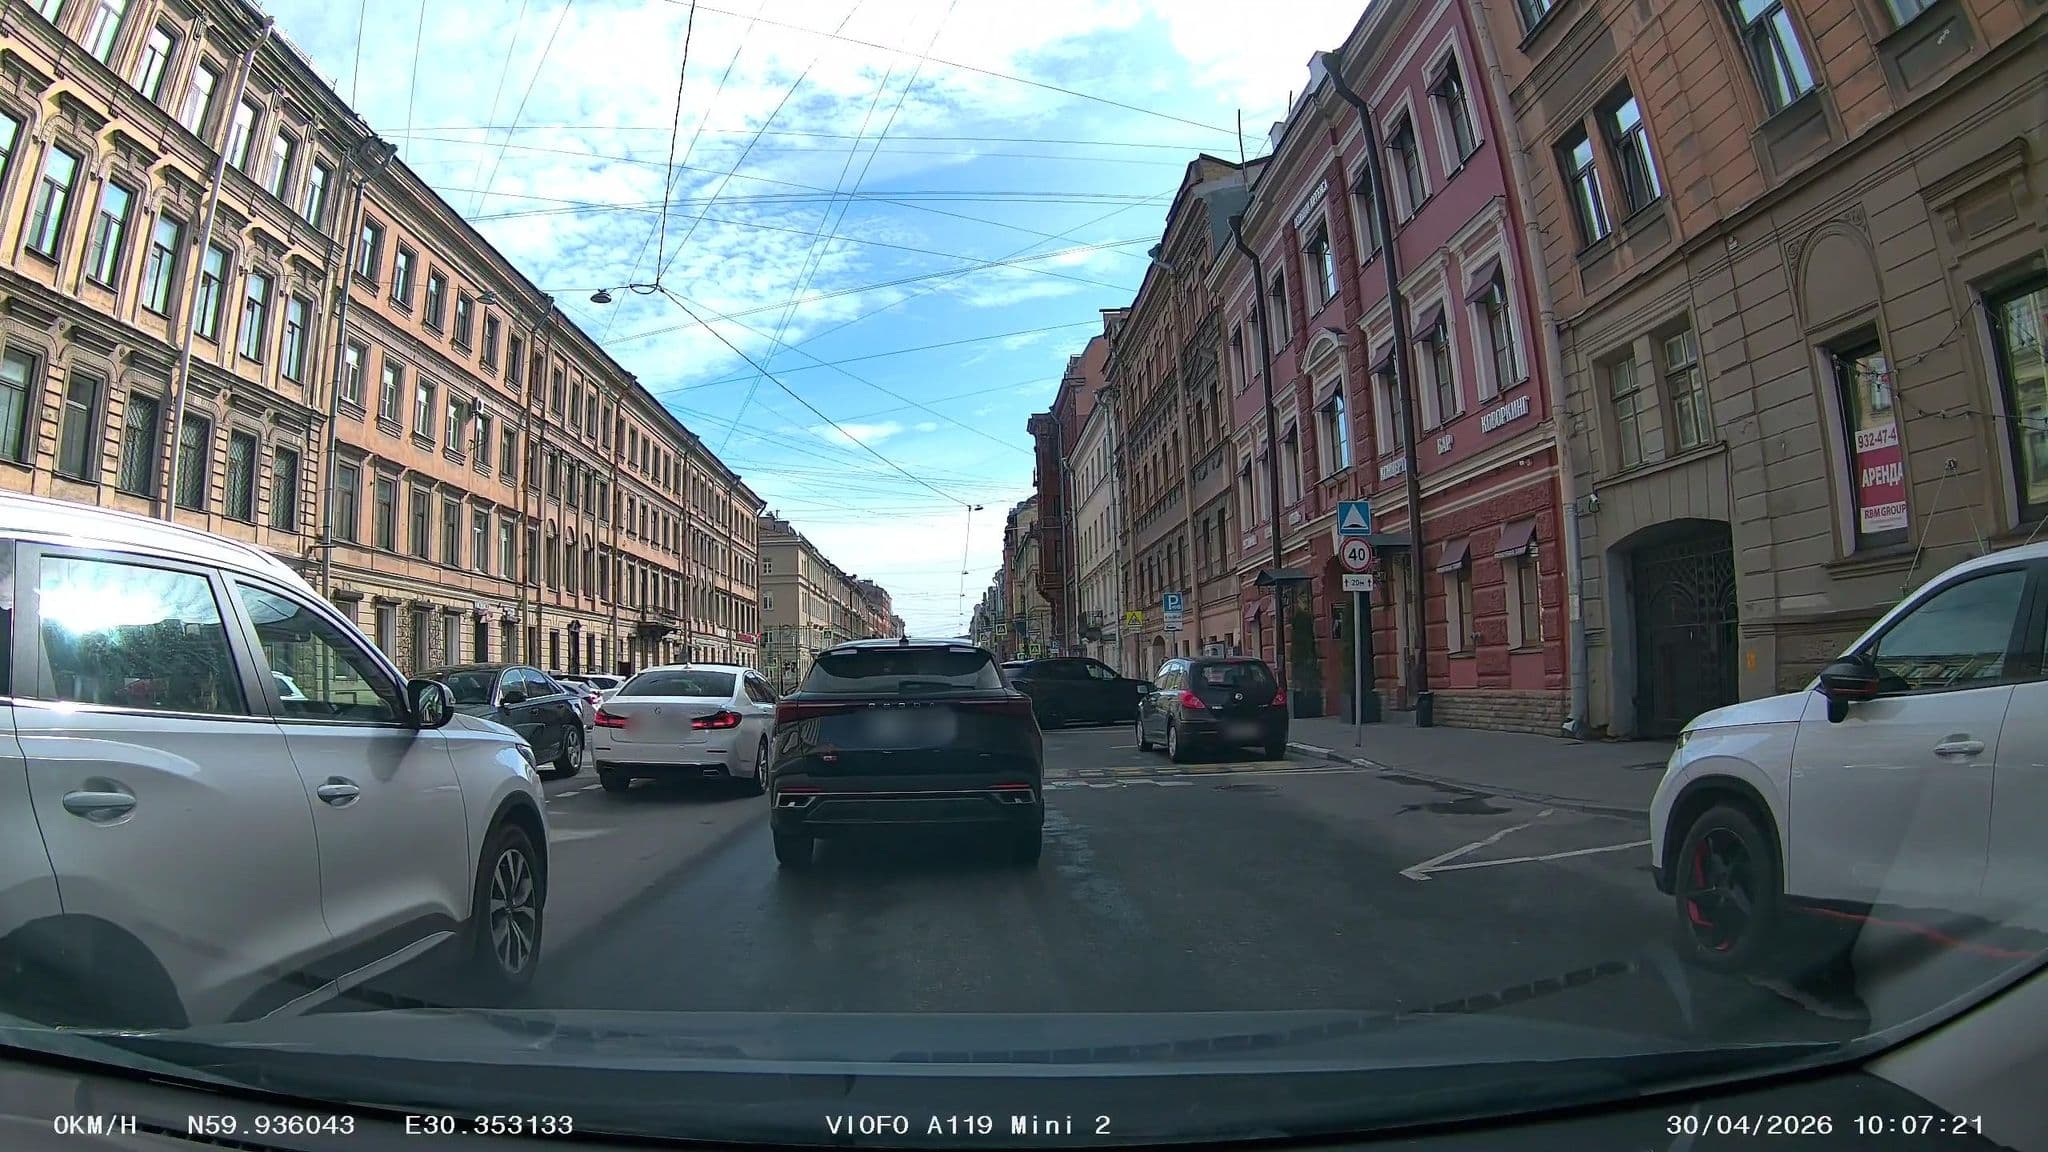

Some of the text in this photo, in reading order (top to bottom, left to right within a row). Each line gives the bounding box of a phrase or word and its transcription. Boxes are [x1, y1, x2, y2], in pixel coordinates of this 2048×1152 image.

[1481, 396, 1530, 433] КОВОРКИНГ
[1437, 434, 1452, 455] БАР
[1862, 462, 1904, 488] АРЕНДА
[1880, 503, 1907, 517] GROUP
[1348, 547, 1366, 561] 40
